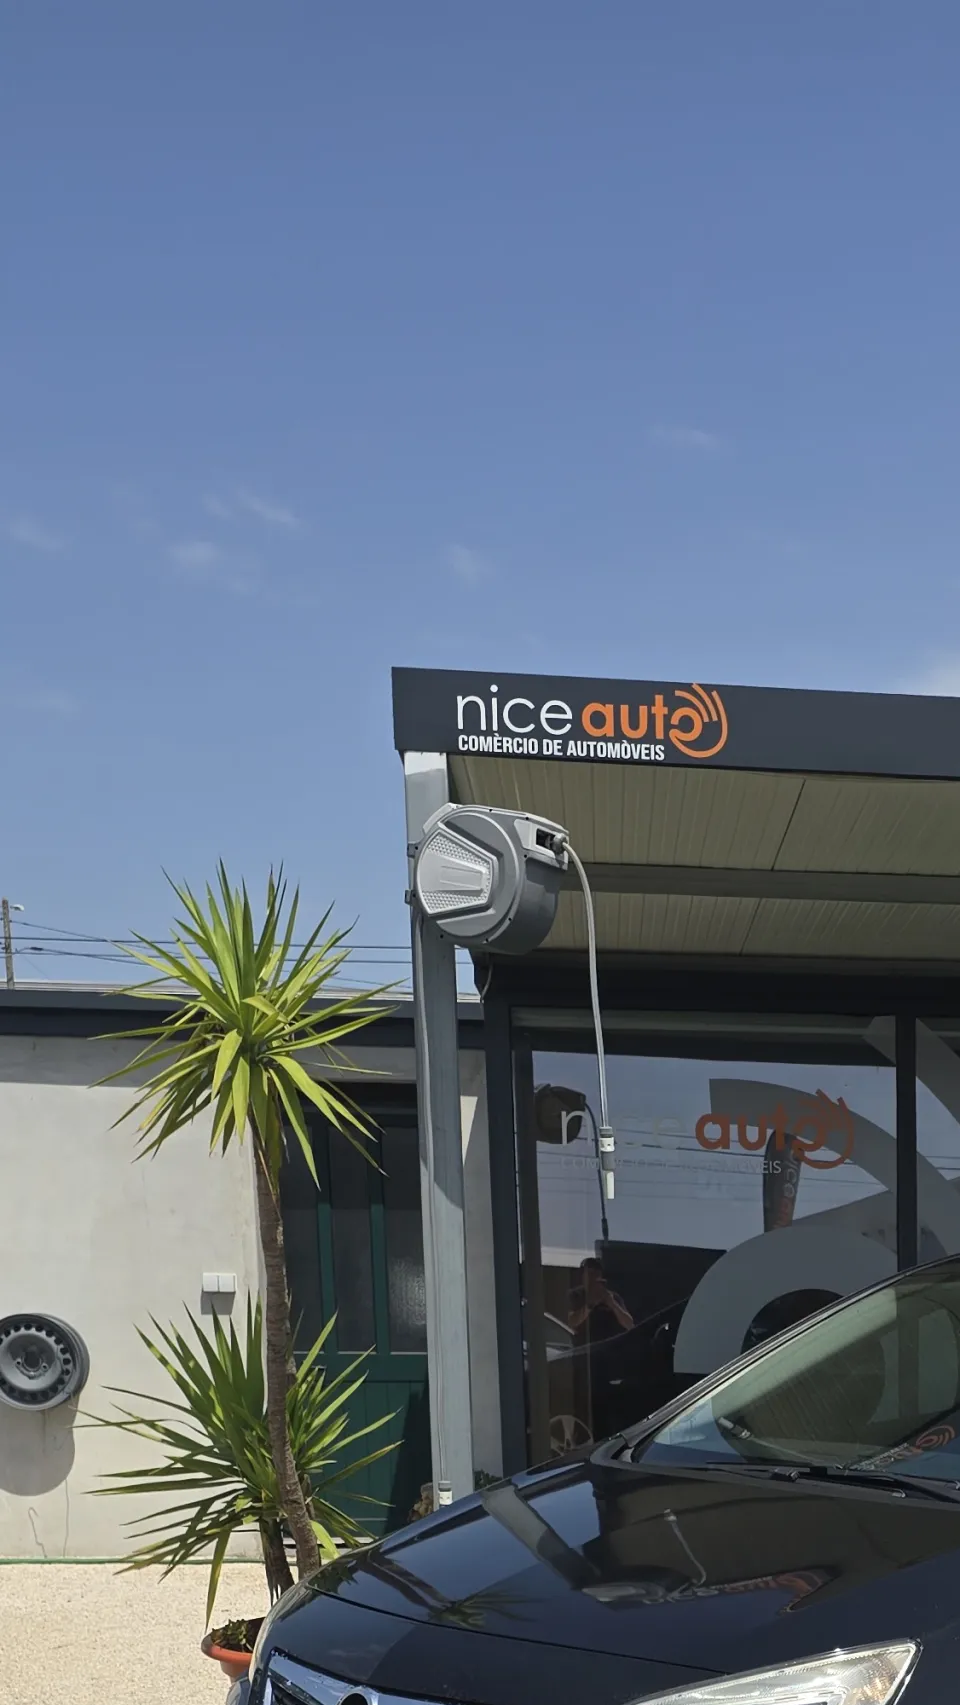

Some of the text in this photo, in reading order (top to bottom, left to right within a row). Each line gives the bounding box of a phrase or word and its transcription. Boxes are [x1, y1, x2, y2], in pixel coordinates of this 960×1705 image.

[458, 732, 665, 761] COMÈRCIO DE AUTOMÒVEIS
